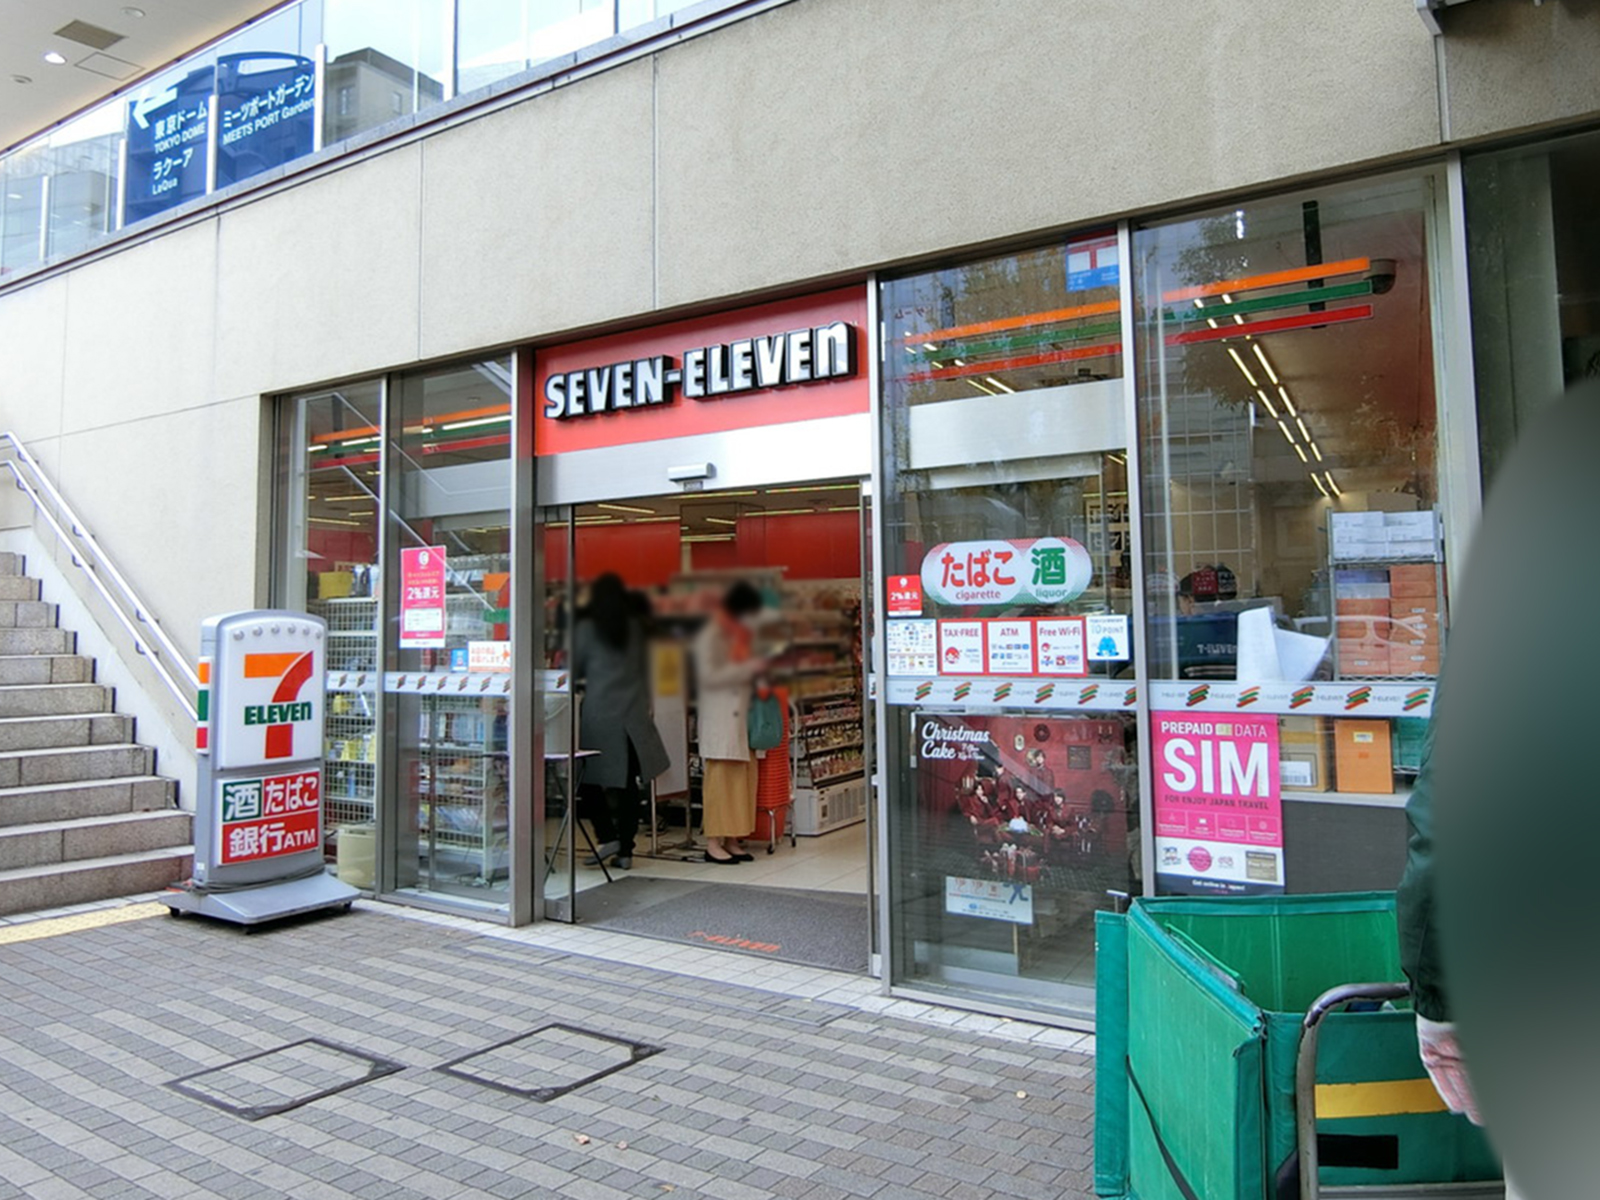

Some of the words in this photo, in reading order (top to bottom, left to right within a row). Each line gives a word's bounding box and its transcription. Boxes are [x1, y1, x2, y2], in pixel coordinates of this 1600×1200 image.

[223, 74, 314, 128] ミーツポートガーデン
[154, 101, 208, 140] 東京ドーム
[222, 122, 254, 146] MEETS
[254, 110, 280, 133] PORT
[281, 97, 315, 120] Garden
[153, 133, 181, 154] TOKYO
[182, 122, 206, 143] DOME
[153, 147, 194, 180] ラクーア
[152, 177, 178, 195] LaQua
[941, 549, 1016, 589] たばこ
[1031, 547, 1067, 586] 酒
[955, 590, 1001, 601] cigarette
[1035, 588, 1067, 599] liquor
[1000, 628, 1019, 637] ATM
[1039, 627, 1057, 637] Free
[1058, 626, 1081, 636] Wi-Fi
[244, 651, 313, 759] 7
[922, 721, 991, 742] Christmas
[1161, 721, 1213, 735] PREPAID
[1234, 724, 1268, 738] DATA
[921, 740, 956, 759] Cake
[1163, 738, 1270, 797] SIM
[225, 784, 260, 821] 酒
[264, 776, 319, 815] たばこ
[1164, 794, 1180, 803] FOR
[1182, 795, 1207, 805] ENJOY
[1209, 797, 1236, 807] JAPAN
[1238, 800, 1270, 810] TRAVEL
[228, 822, 286, 859] 銀行
[283, 828, 316, 849] ATM
